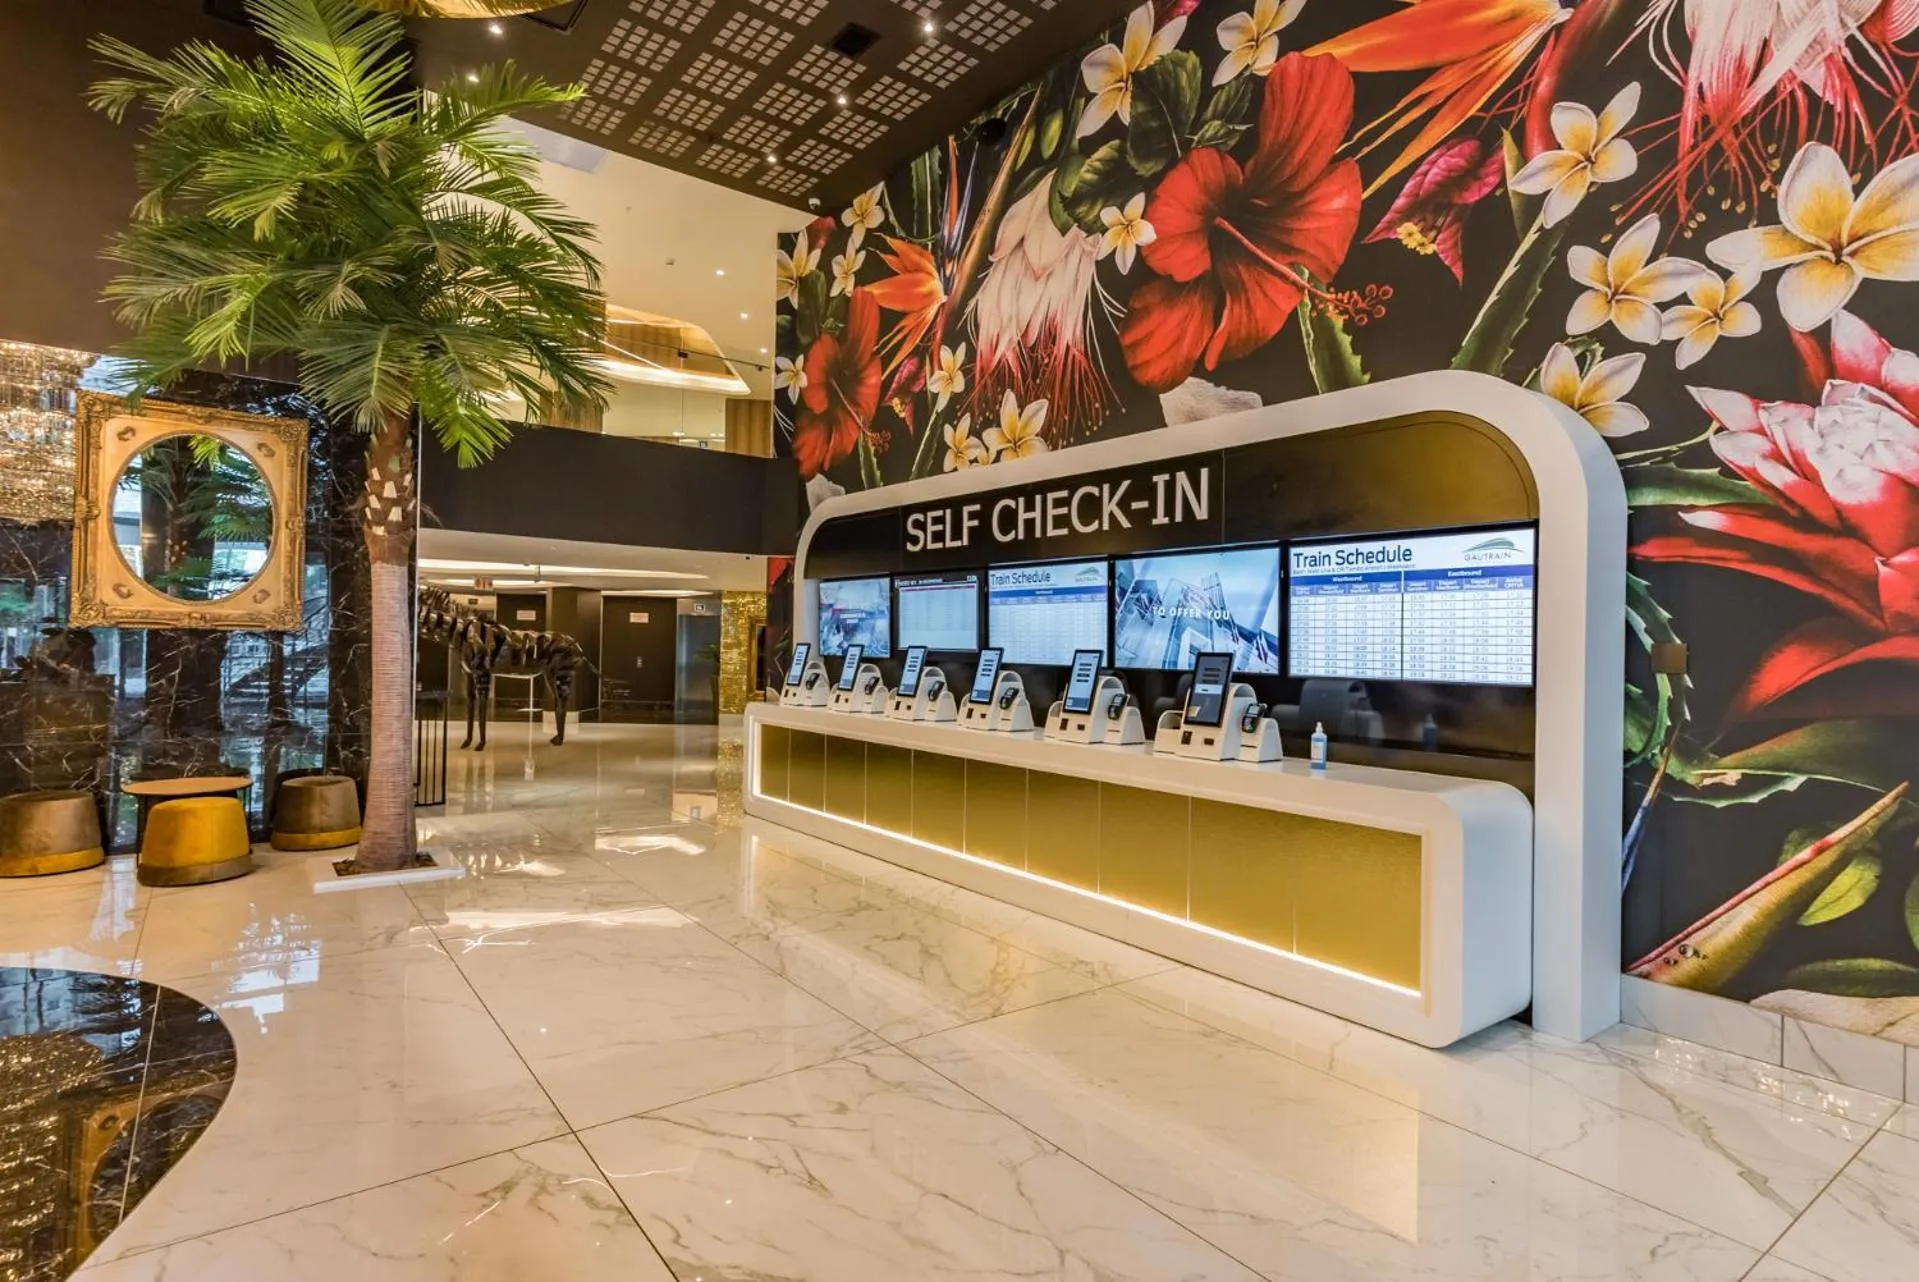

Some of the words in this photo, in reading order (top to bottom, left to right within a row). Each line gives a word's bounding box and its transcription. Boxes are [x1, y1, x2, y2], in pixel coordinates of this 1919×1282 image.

[906, 504, 981, 552] SELF
[992, 467, 1209, 543] CHECK-IN
[1293, 551, 1331, 568] Train
[1335, 545, 1412, 566] Schedule
[1464, 551, 1512, 562] GAUTRAIN
[991, 574, 1010, 585] Train
[1012, 570, 1051, 585] Schedule
[1153, 607, 1165, 616] TO
[1170, 607, 1202, 617] OFFER
[1207, 610, 1230, 620] YOU
